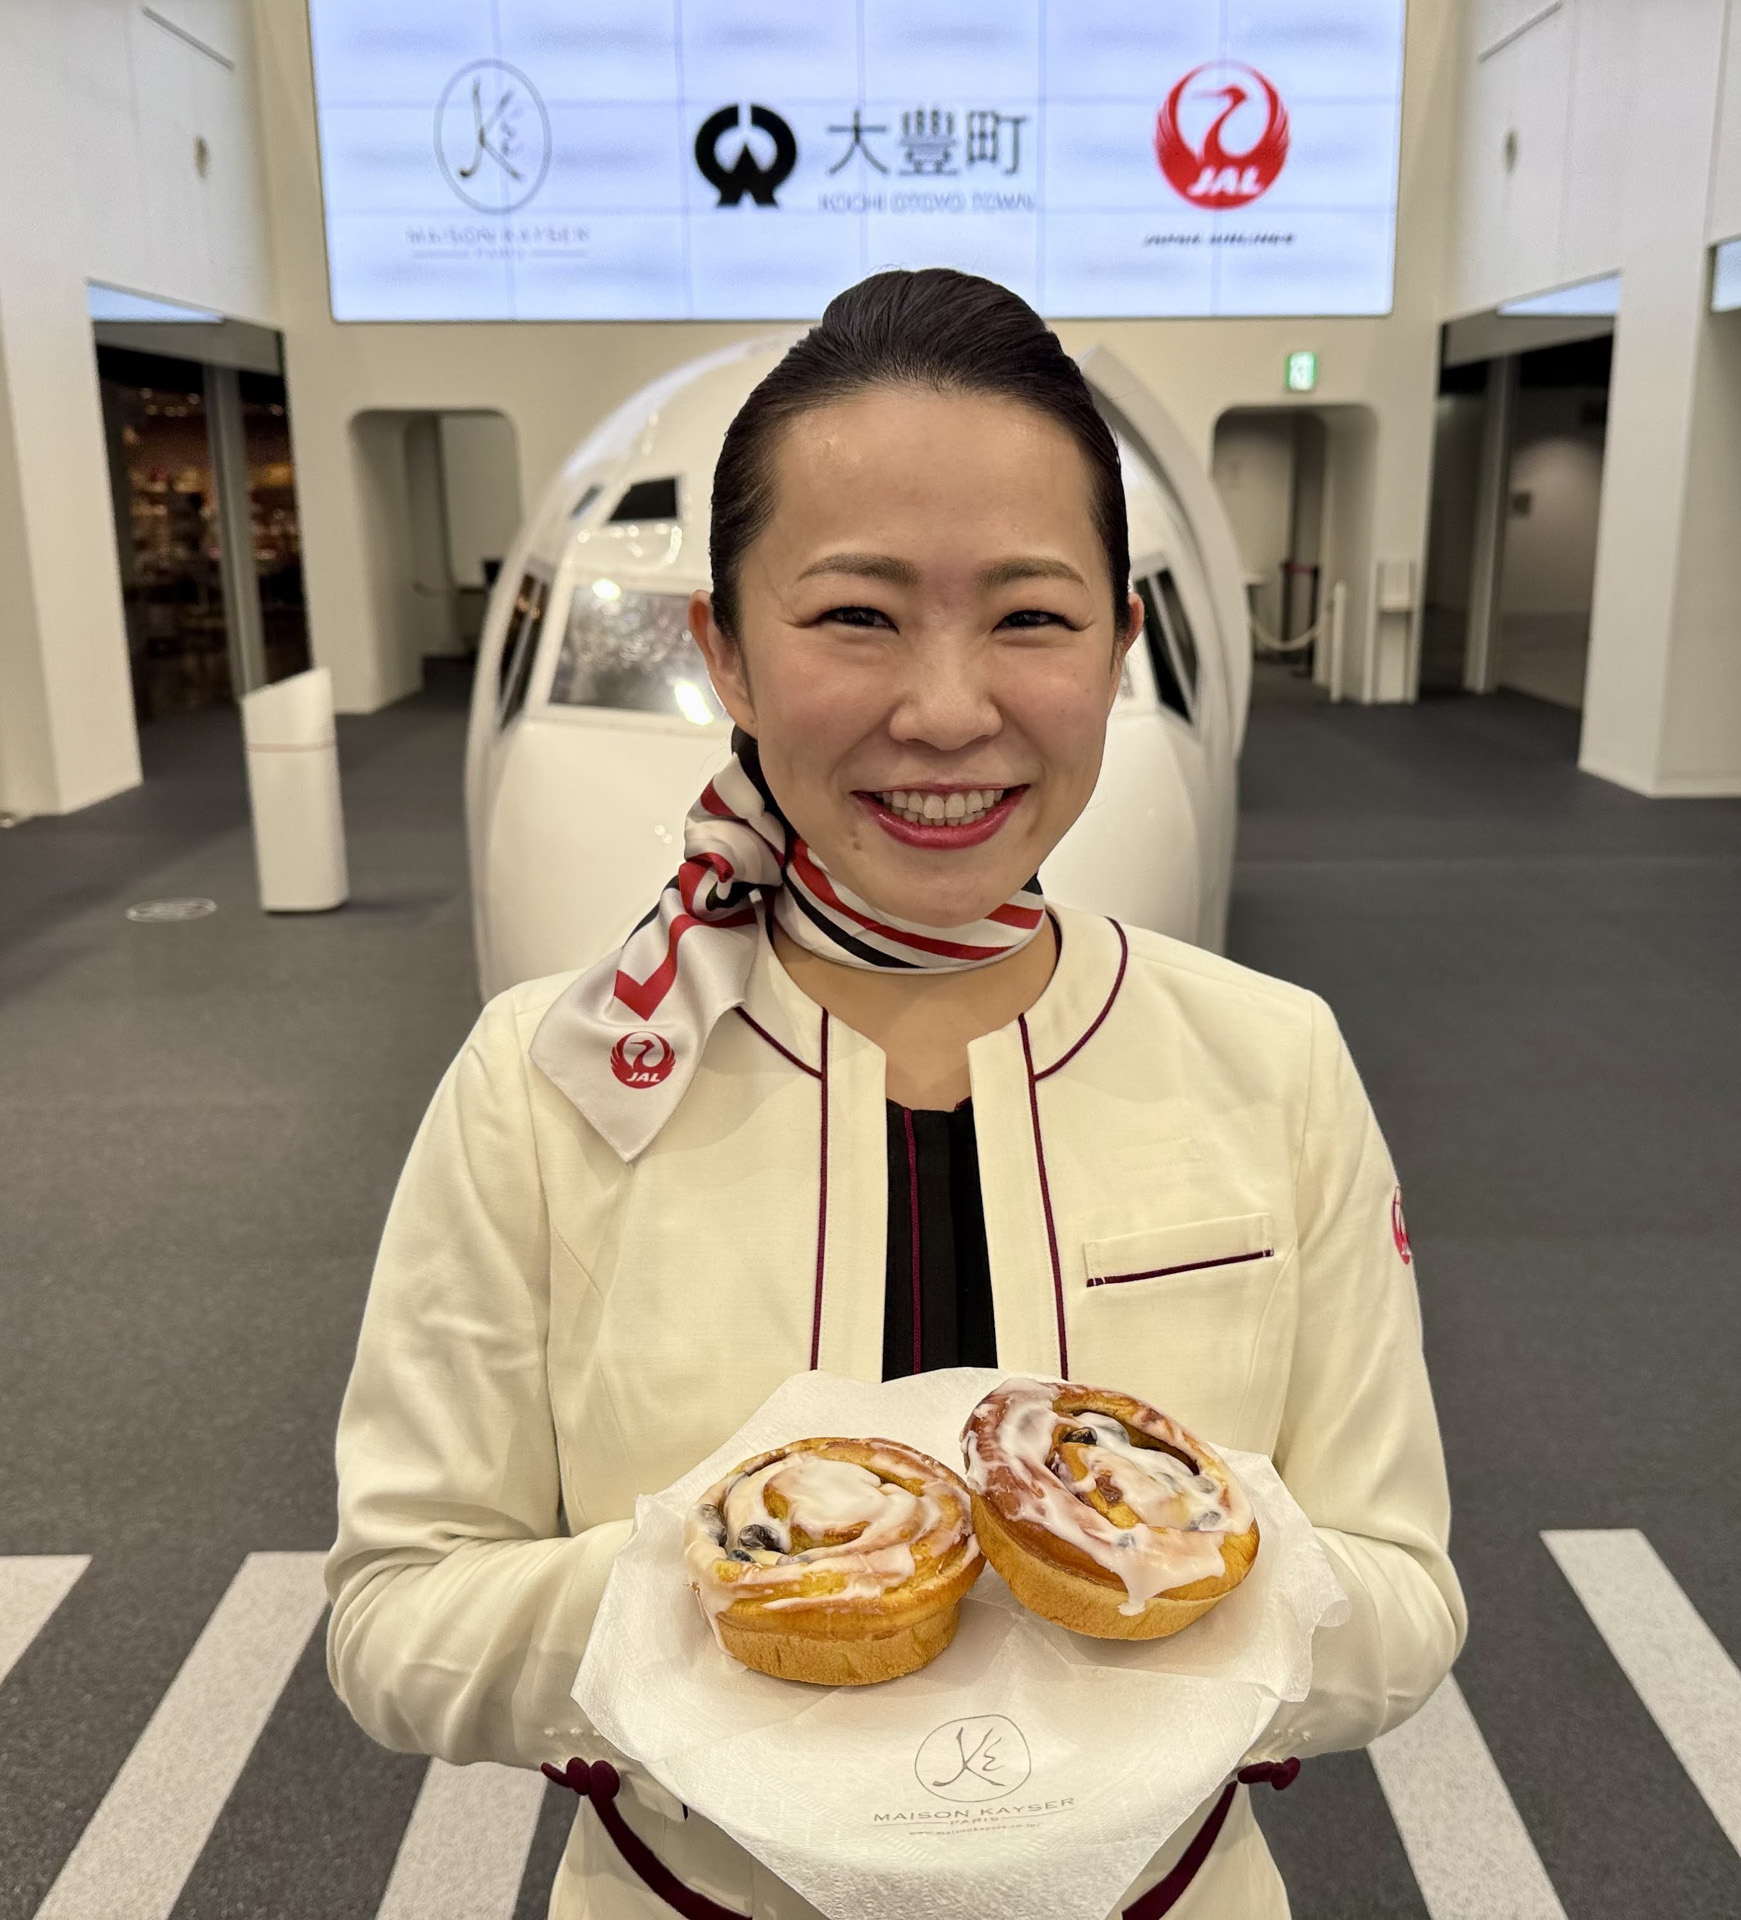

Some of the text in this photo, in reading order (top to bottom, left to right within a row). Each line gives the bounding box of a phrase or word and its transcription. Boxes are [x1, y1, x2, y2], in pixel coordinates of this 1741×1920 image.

[826, 108, 1030, 176] 大豊町
[1187, 166, 1265, 196] JAL
[818, 192, 884, 212] KOCHI
[971, 191, 1036, 211] TOWN
[406, 226, 496, 243] MAISON
[626, 1072, 661, 1083] JAL
[873, 1798, 1075, 1822] MAISON KAYSER
[949, 1816, 1000, 1826] PARIS
